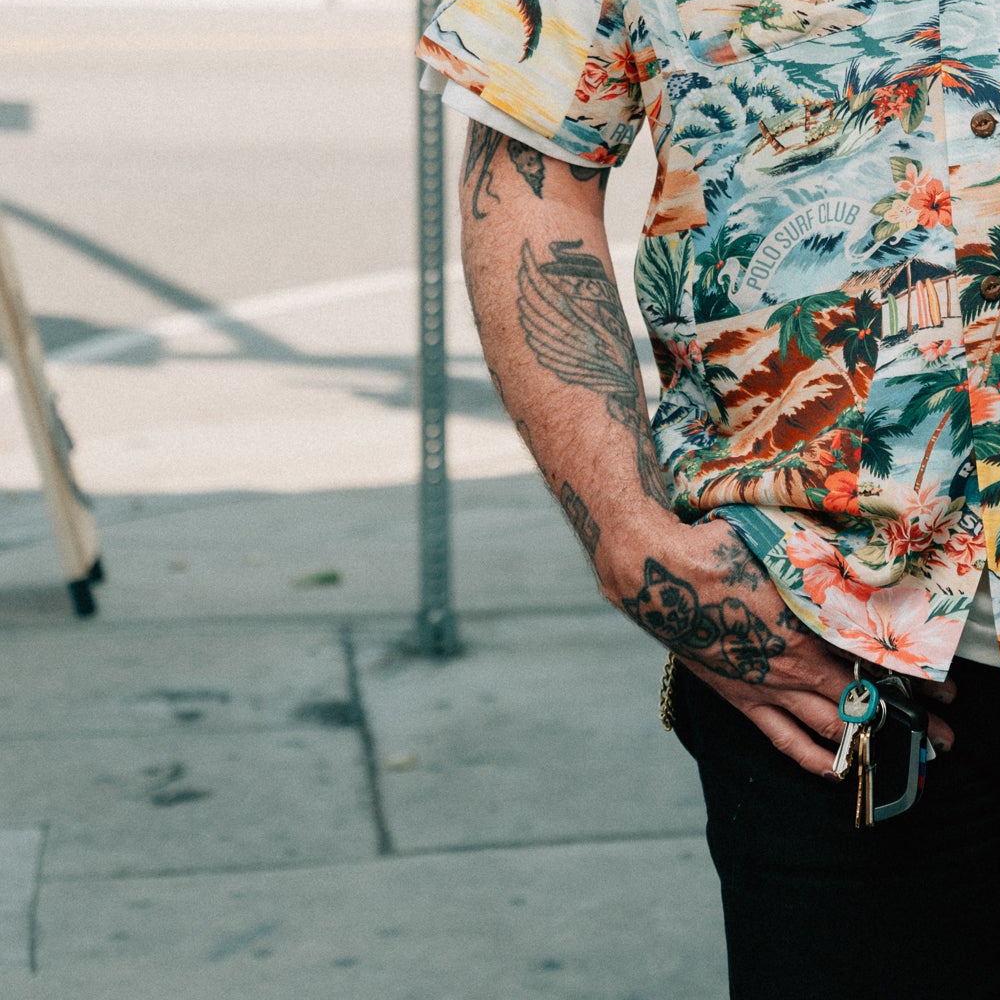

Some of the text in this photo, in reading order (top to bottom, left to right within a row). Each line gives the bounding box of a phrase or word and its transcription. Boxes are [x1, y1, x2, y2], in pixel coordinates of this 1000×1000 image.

[746, 201, 861, 291] POLO SURF CLUB
